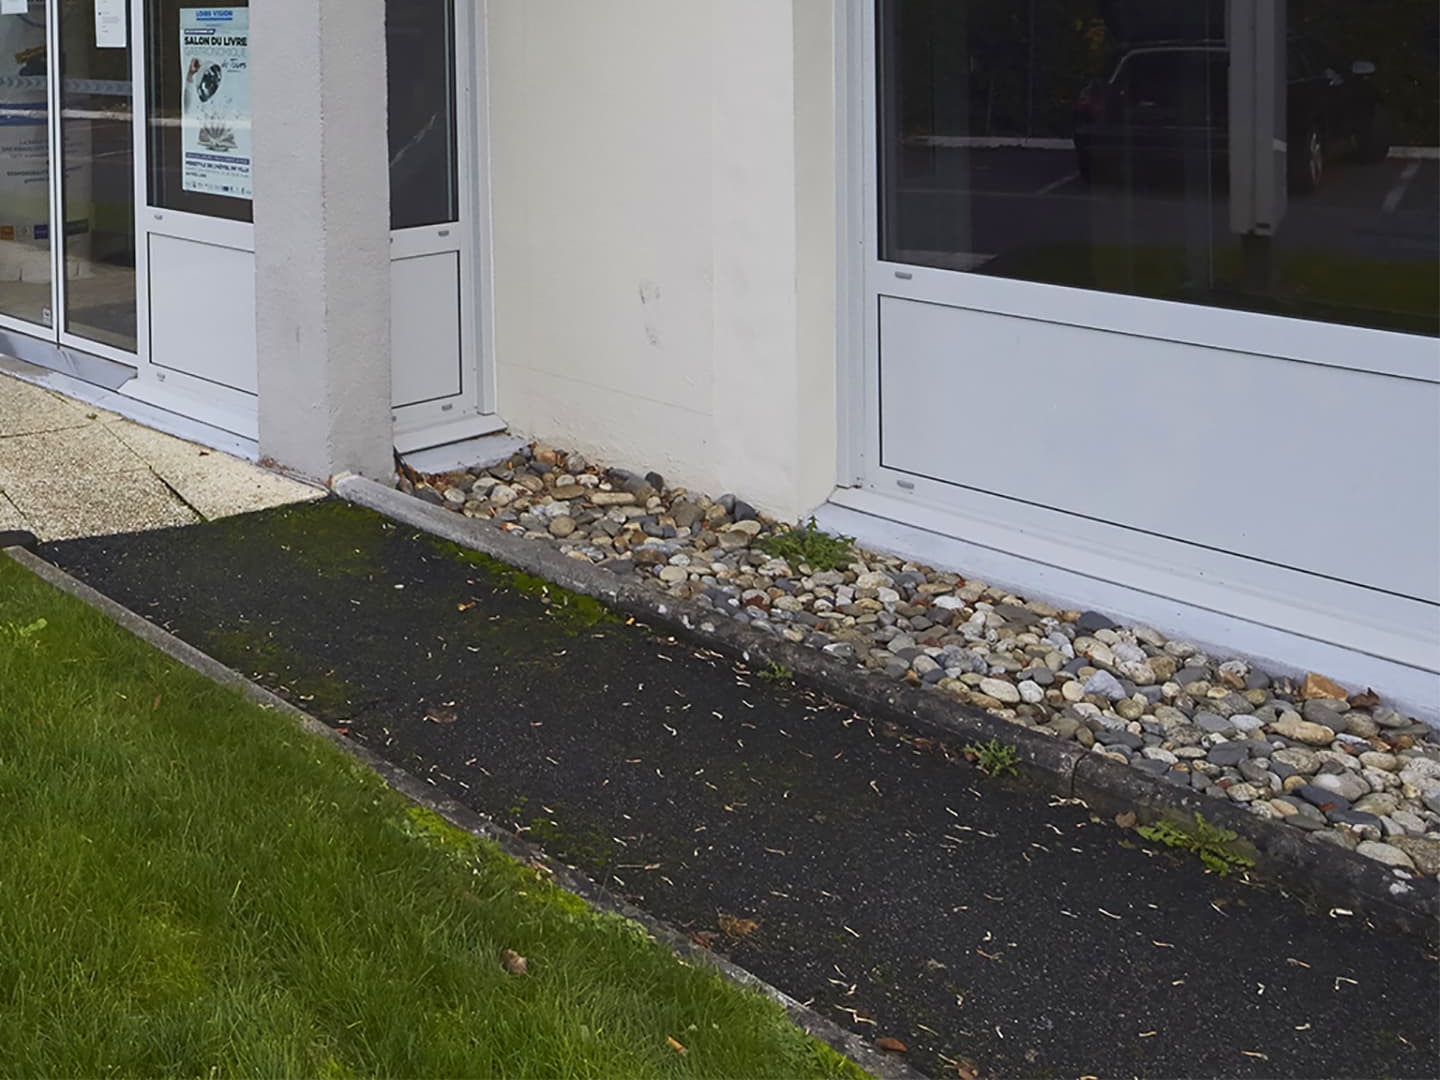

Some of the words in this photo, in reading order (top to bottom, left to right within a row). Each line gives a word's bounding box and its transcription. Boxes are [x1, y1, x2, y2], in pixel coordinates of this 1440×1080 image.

[184, 36, 210, 45] SALON
[211, 37, 222, 46] DU
[224, 37, 248, 47] LIVRE
